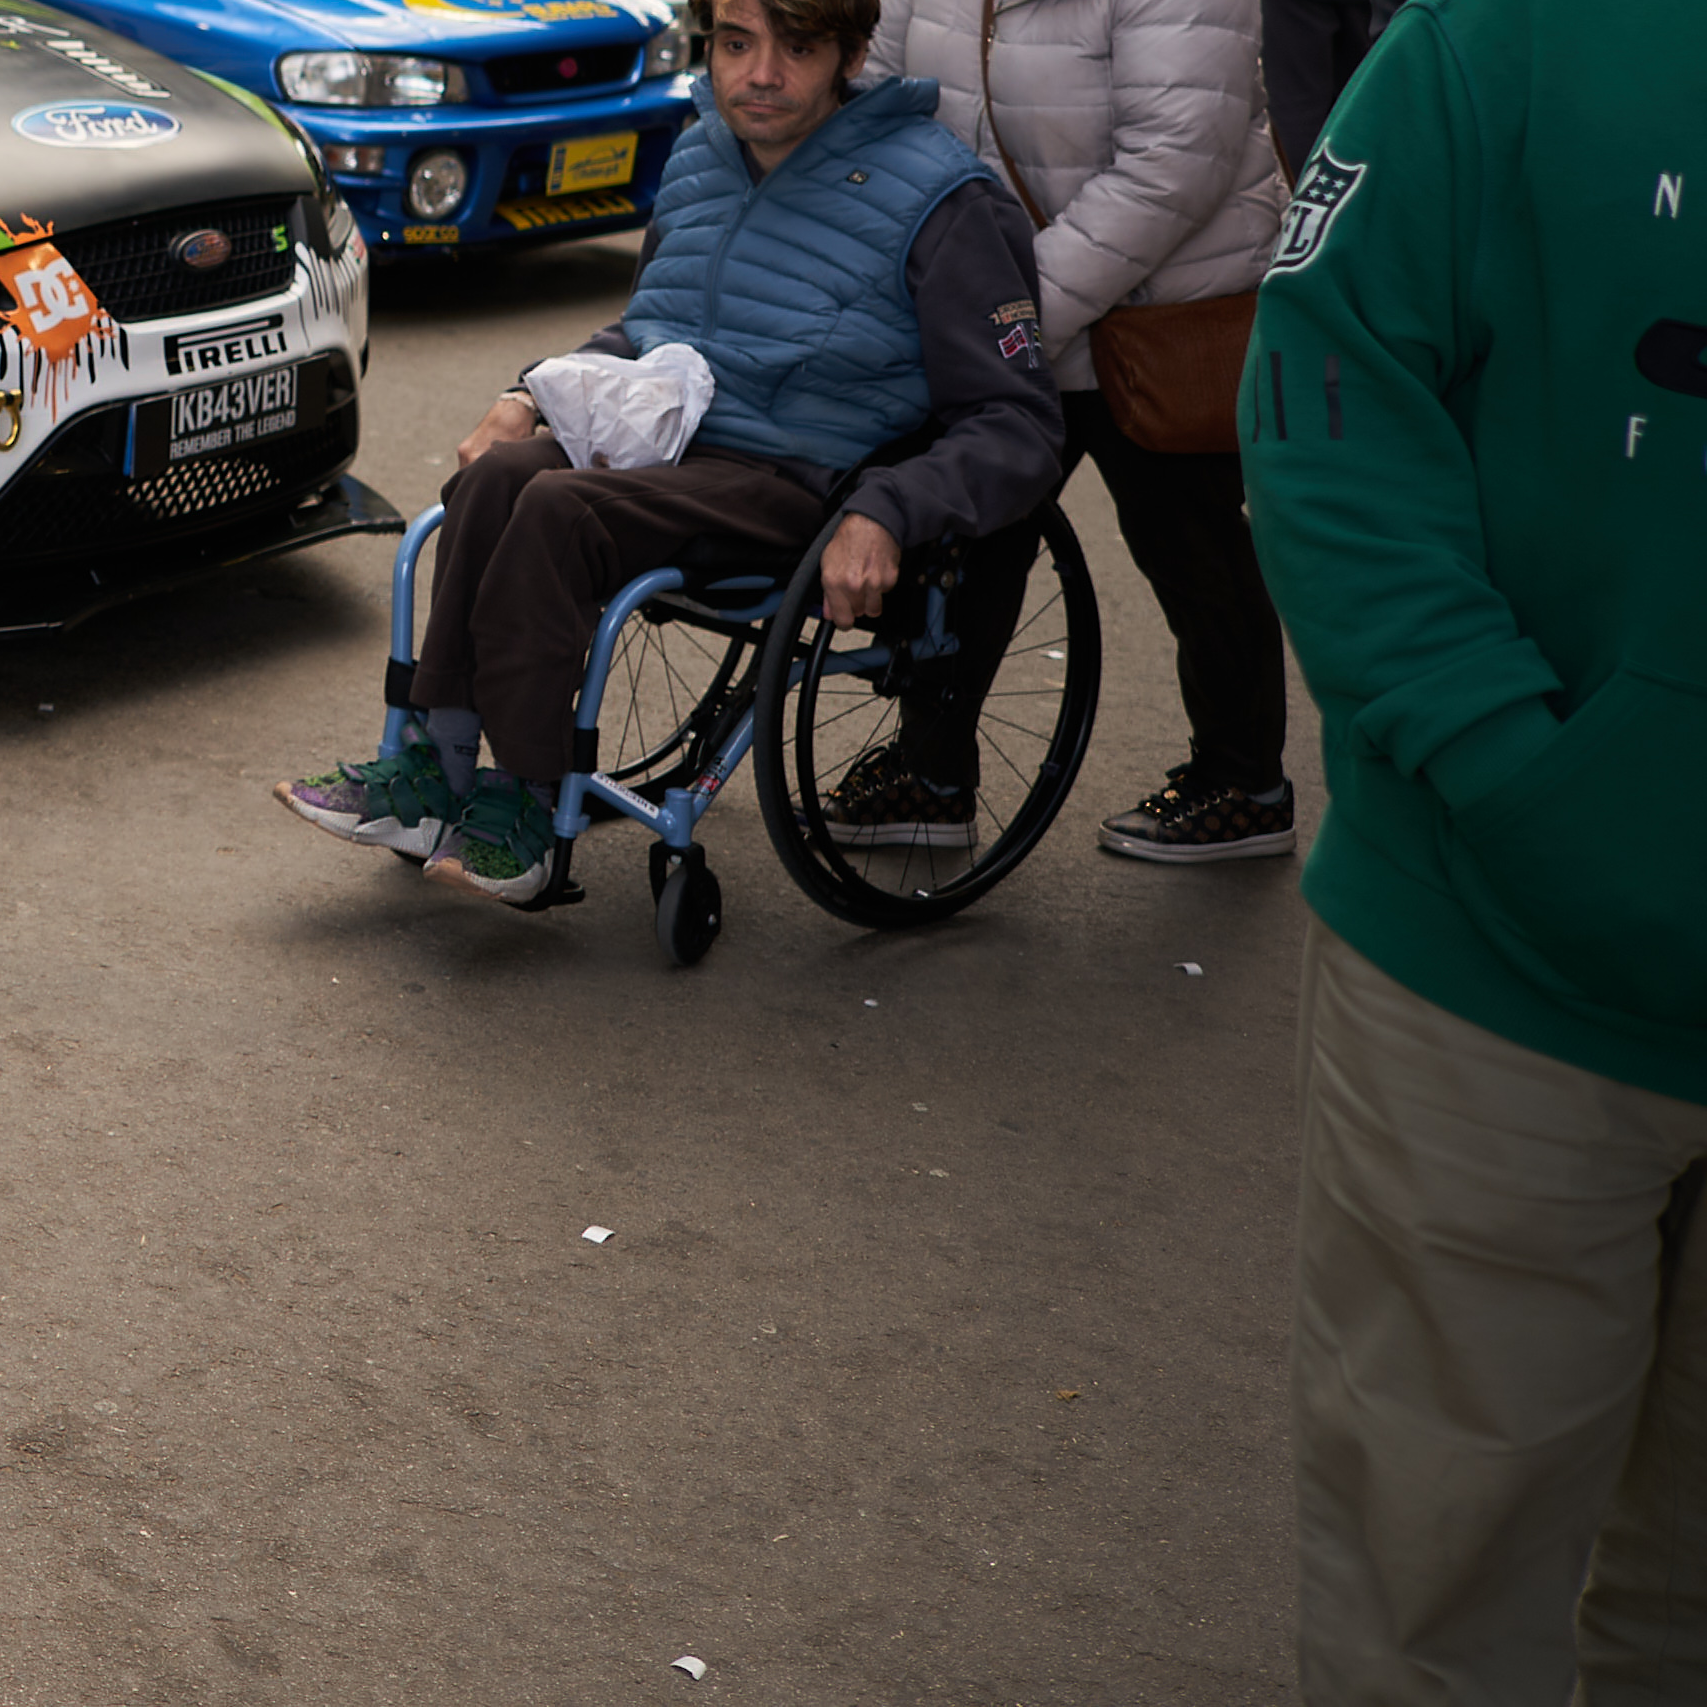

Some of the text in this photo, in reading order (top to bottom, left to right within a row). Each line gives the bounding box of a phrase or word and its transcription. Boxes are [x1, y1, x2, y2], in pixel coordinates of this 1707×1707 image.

[45, 104, 159, 144] Ford
[164, 314, 288, 375] PIRELLI
[170, 364, 298, 440] [KB43VER]
[169, 410, 296, 460] REMEMBER THE LEGEND
